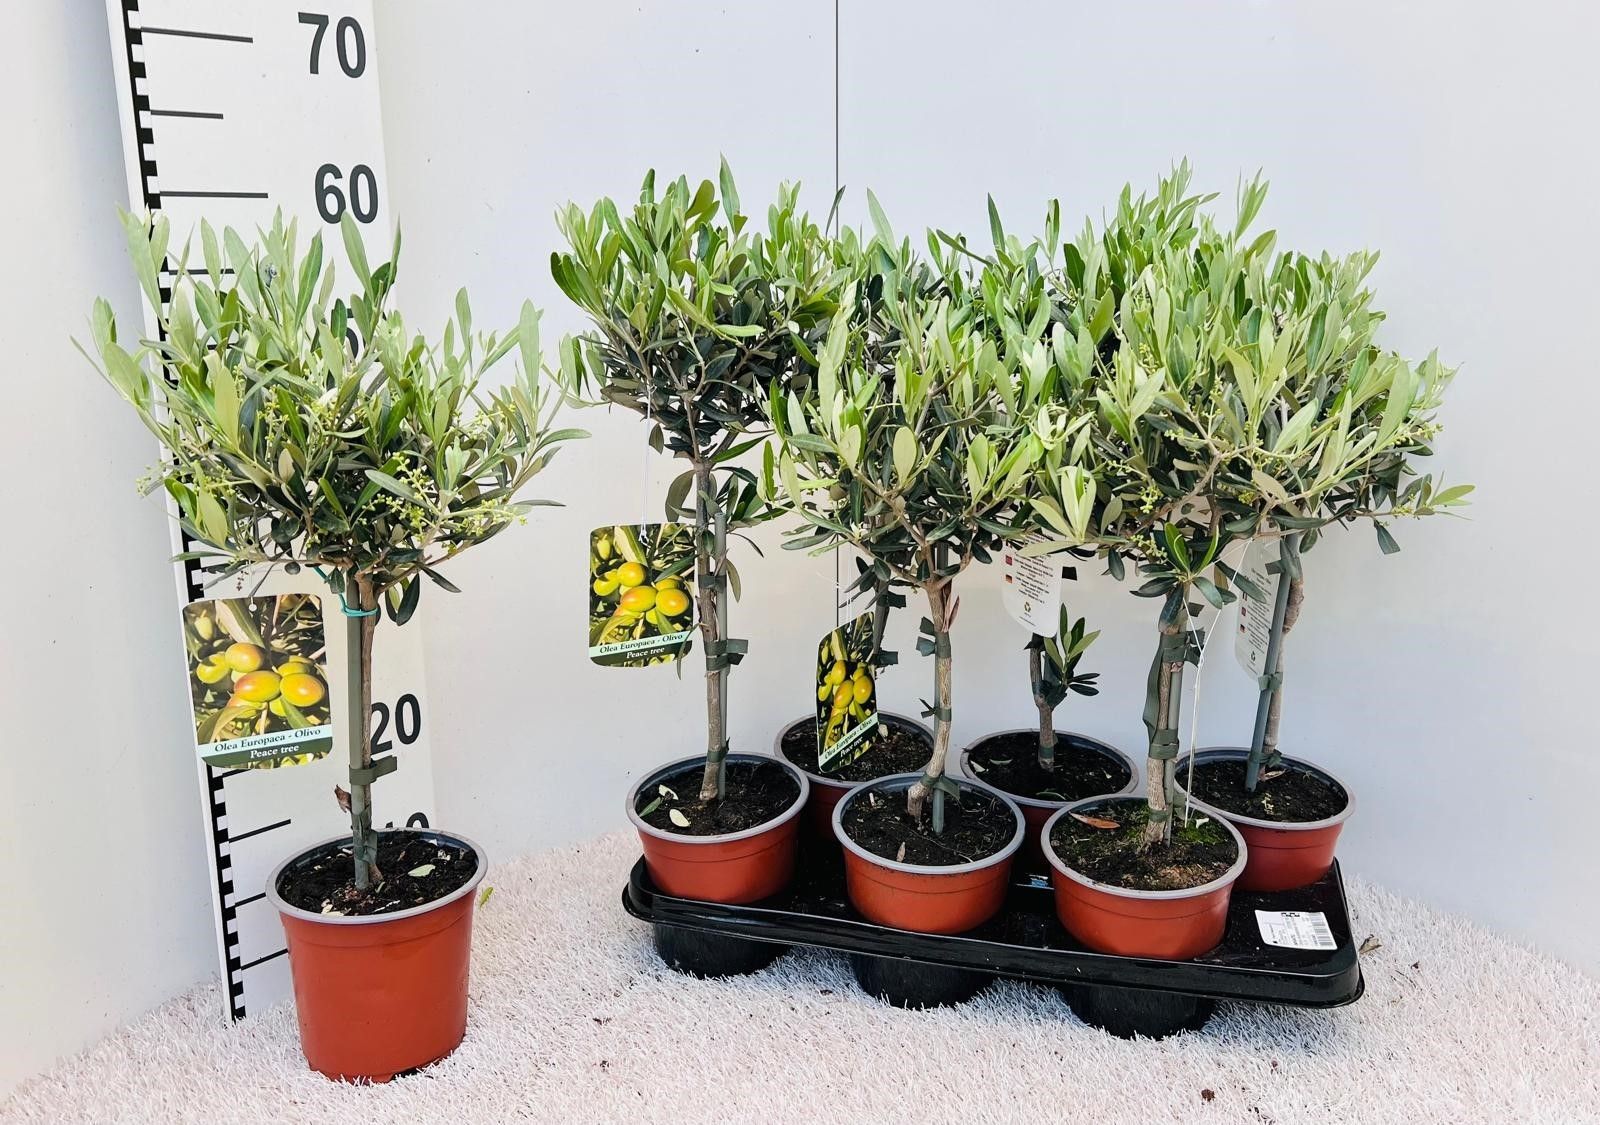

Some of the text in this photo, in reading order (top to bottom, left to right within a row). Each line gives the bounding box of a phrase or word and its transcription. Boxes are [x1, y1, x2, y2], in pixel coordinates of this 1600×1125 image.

[297, 11, 367, 79] 70
[314, 163, 379, 224] 60
[599, 646, 618, 654] Olea
[662, 633, 683, 642] Olivo
[626, 646, 665, 659] Peace tree
[371, 693, 421, 755] 20
[214, 743, 238, 752] Olea
[240, 734, 286, 748] Europaea
[294, 728, 321, 738] Olivo
[250, 744, 300, 759] Peace tree
